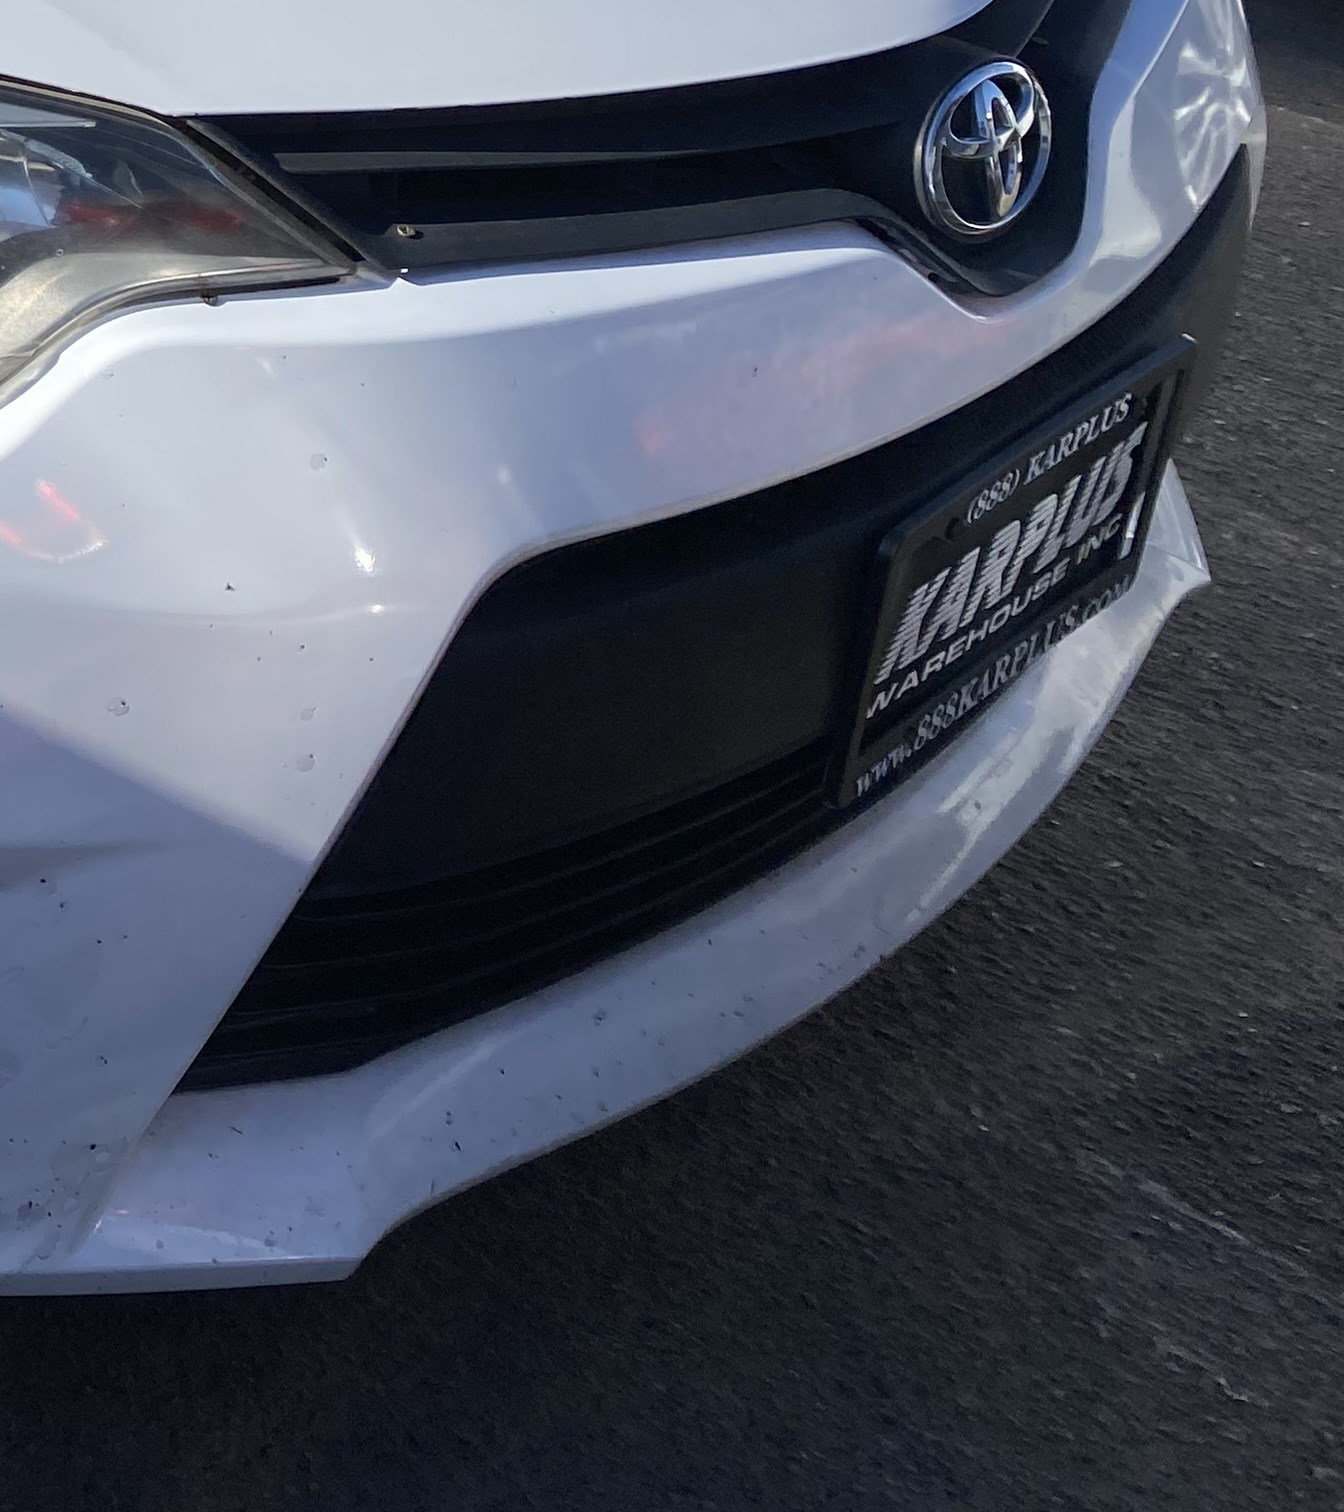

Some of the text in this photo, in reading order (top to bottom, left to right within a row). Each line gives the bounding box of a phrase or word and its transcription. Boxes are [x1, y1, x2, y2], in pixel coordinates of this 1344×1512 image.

[873, 420, 1148, 686] KARPLUS
[967, 392, 1132, 524] (888) KARPLUS
[865, 512, 1123, 720] WAREHOUSE INC
